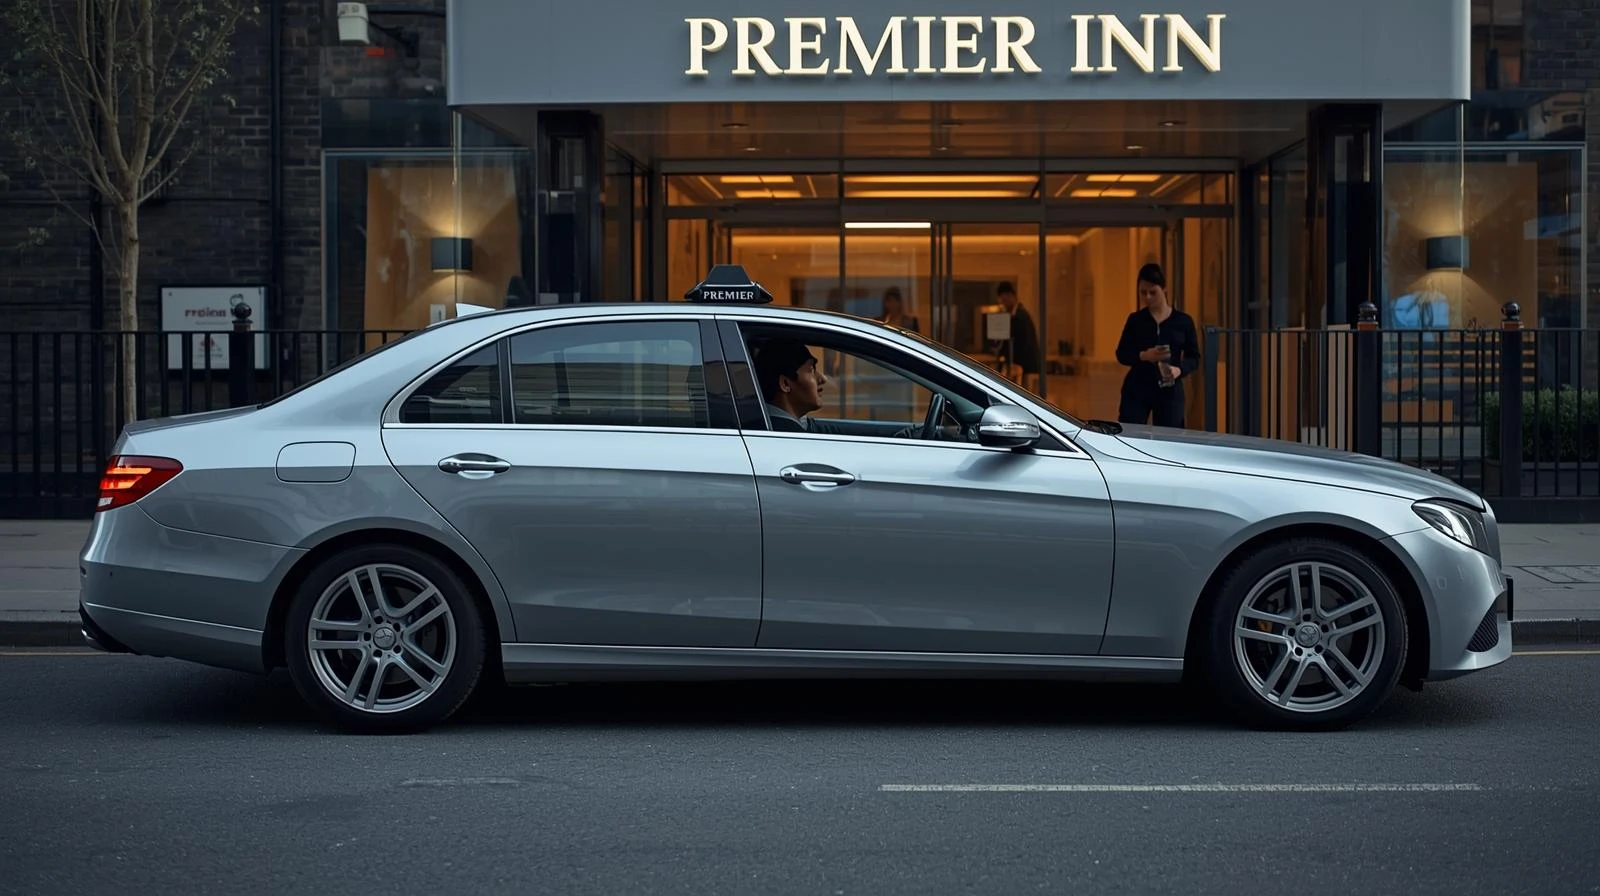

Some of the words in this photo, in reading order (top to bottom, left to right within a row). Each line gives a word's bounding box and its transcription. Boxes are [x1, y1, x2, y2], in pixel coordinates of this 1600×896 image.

[684, 15, 1042, 76] PREMIER
[1070, 13, 1227, 74] INN
[703, 291, 754, 300] PREMIER
